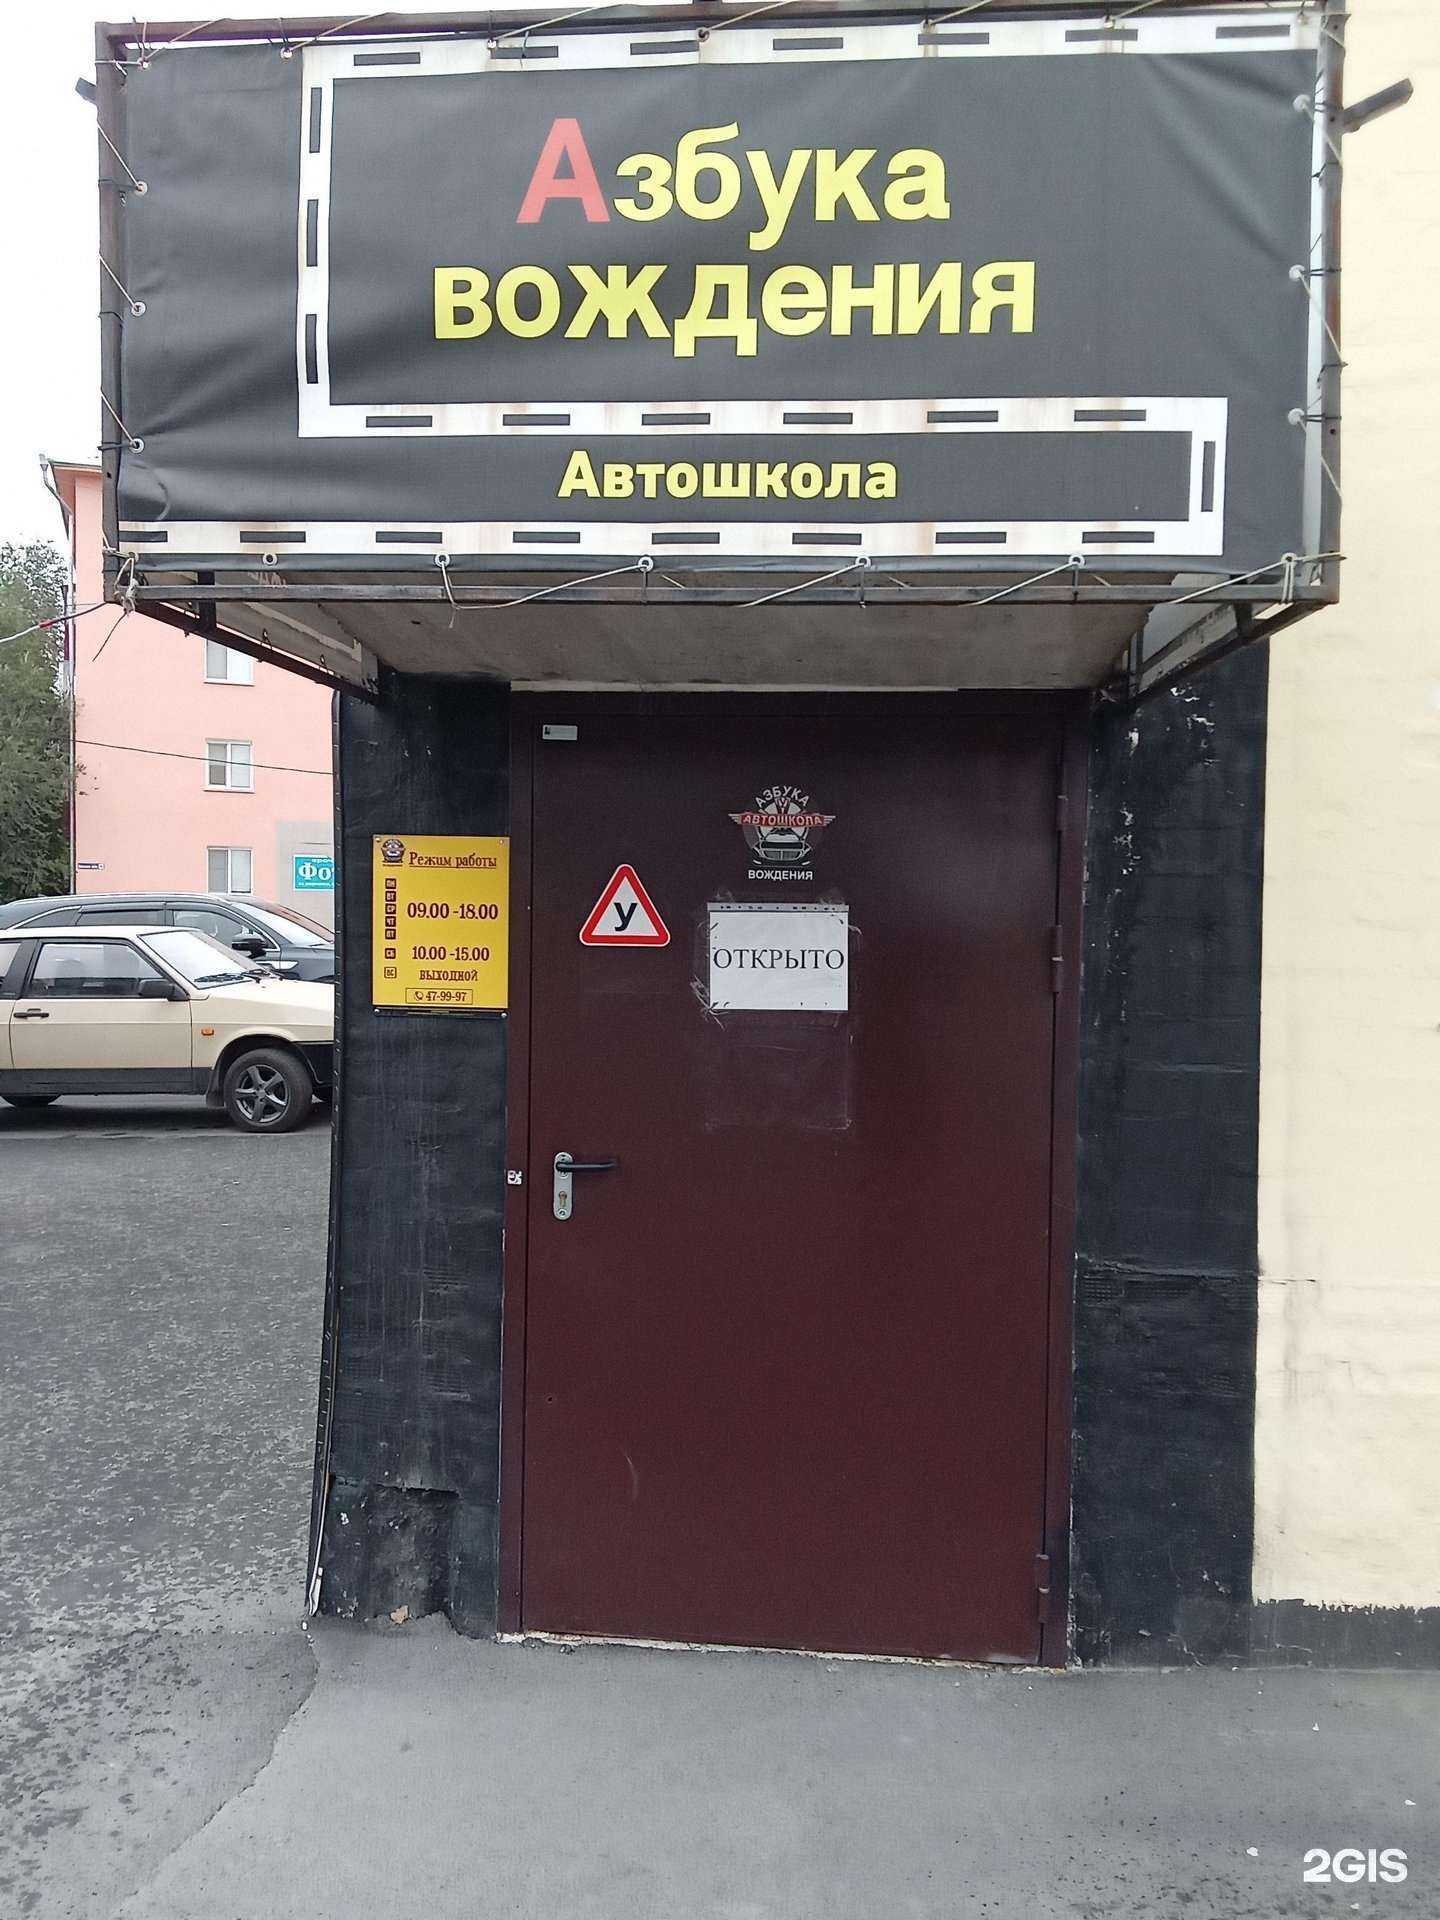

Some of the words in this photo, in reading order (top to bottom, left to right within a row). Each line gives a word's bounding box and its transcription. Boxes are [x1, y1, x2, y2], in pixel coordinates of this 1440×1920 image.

[516, 118, 950, 251] Азбука
[434, 261, 1036, 358] вождения
[557, 449, 898, 500] Автошкола
[755, 785, 810, 808] АЗБУКА
[743, 814, 823, 826] АВТОШКОЛА
[409, 851, 451, 866] Режим
[455, 853, 497, 868] работы
[298, 862, 334, 881] Фо
[748, 869, 813, 881] ВОЖДЕНИЯ
[407, 902, 450, 919] 09.00
[412, 946, 447, 960] 10.00
[713, 948, 845, 970] ОТКРЫТО
[425, 991, 467, 1002] 47-99-97
